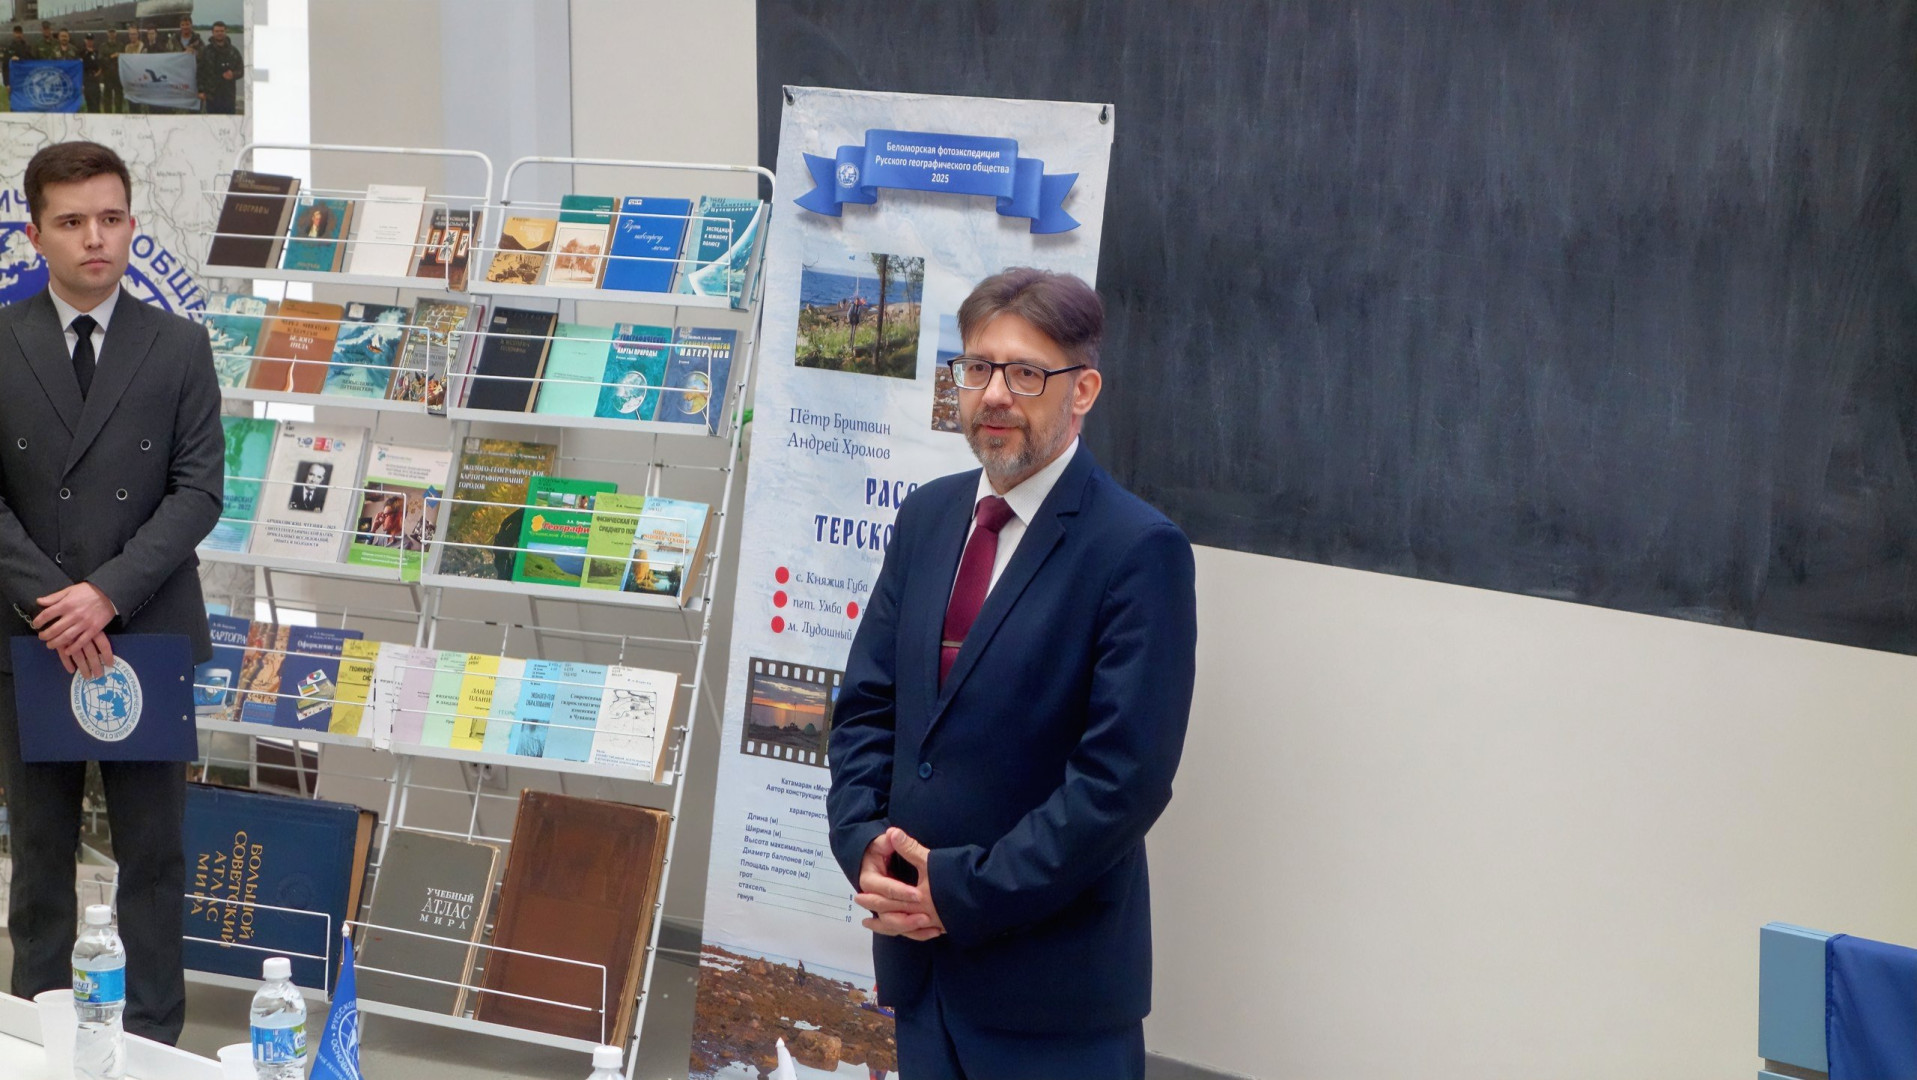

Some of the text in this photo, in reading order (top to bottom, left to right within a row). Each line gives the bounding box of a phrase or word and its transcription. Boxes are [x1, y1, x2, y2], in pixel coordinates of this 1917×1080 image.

[887, 142, 1000, 159] Беломорская фотоэкспедиция
[875, 155, 1010, 174] Русского географического общества
[931, 173, 949, 183] 2025
[789, 408, 891, 436] Пётр Бритвин
[787, 432, 891, 460] Андрей Хромов
[846, 578, 868, 594] Губа
[819, 599, 842, 614] Умба
[801, 621, 853, 641] Лудошный
[766, 783, 785, 795] Автор
[781, 777, 812, 791] Катамаран
[747, 812, 769, 823] Длина
[745, 823, 772, 837] Ширина
[743, 835, 769, 847] Высота
[769, 841, 814, 855] максимальная
[742, 846, 771, 860] Диаметр
[771, 851, 802, 865] баллонов
[739, 870, 753, 880] грот
[740, 858, 770, 871] Площадь
[770, 865, 797, 878] парусов
[190, 853, 211, 915] МИРА
[206, 850, 228, 923] АТЛАС
[218, 830, 248, 949] СОВЕТСКИЙ
[239, 843, 264, 940] БОЛЬШОЙ
[738, 881, 767, 893] стаксель
[426, 887, 475, 904] УЧЕБНЫЙ
[421, 897, 472, 920] АТЛАС
[419, 913, 467, 930] МИРА
